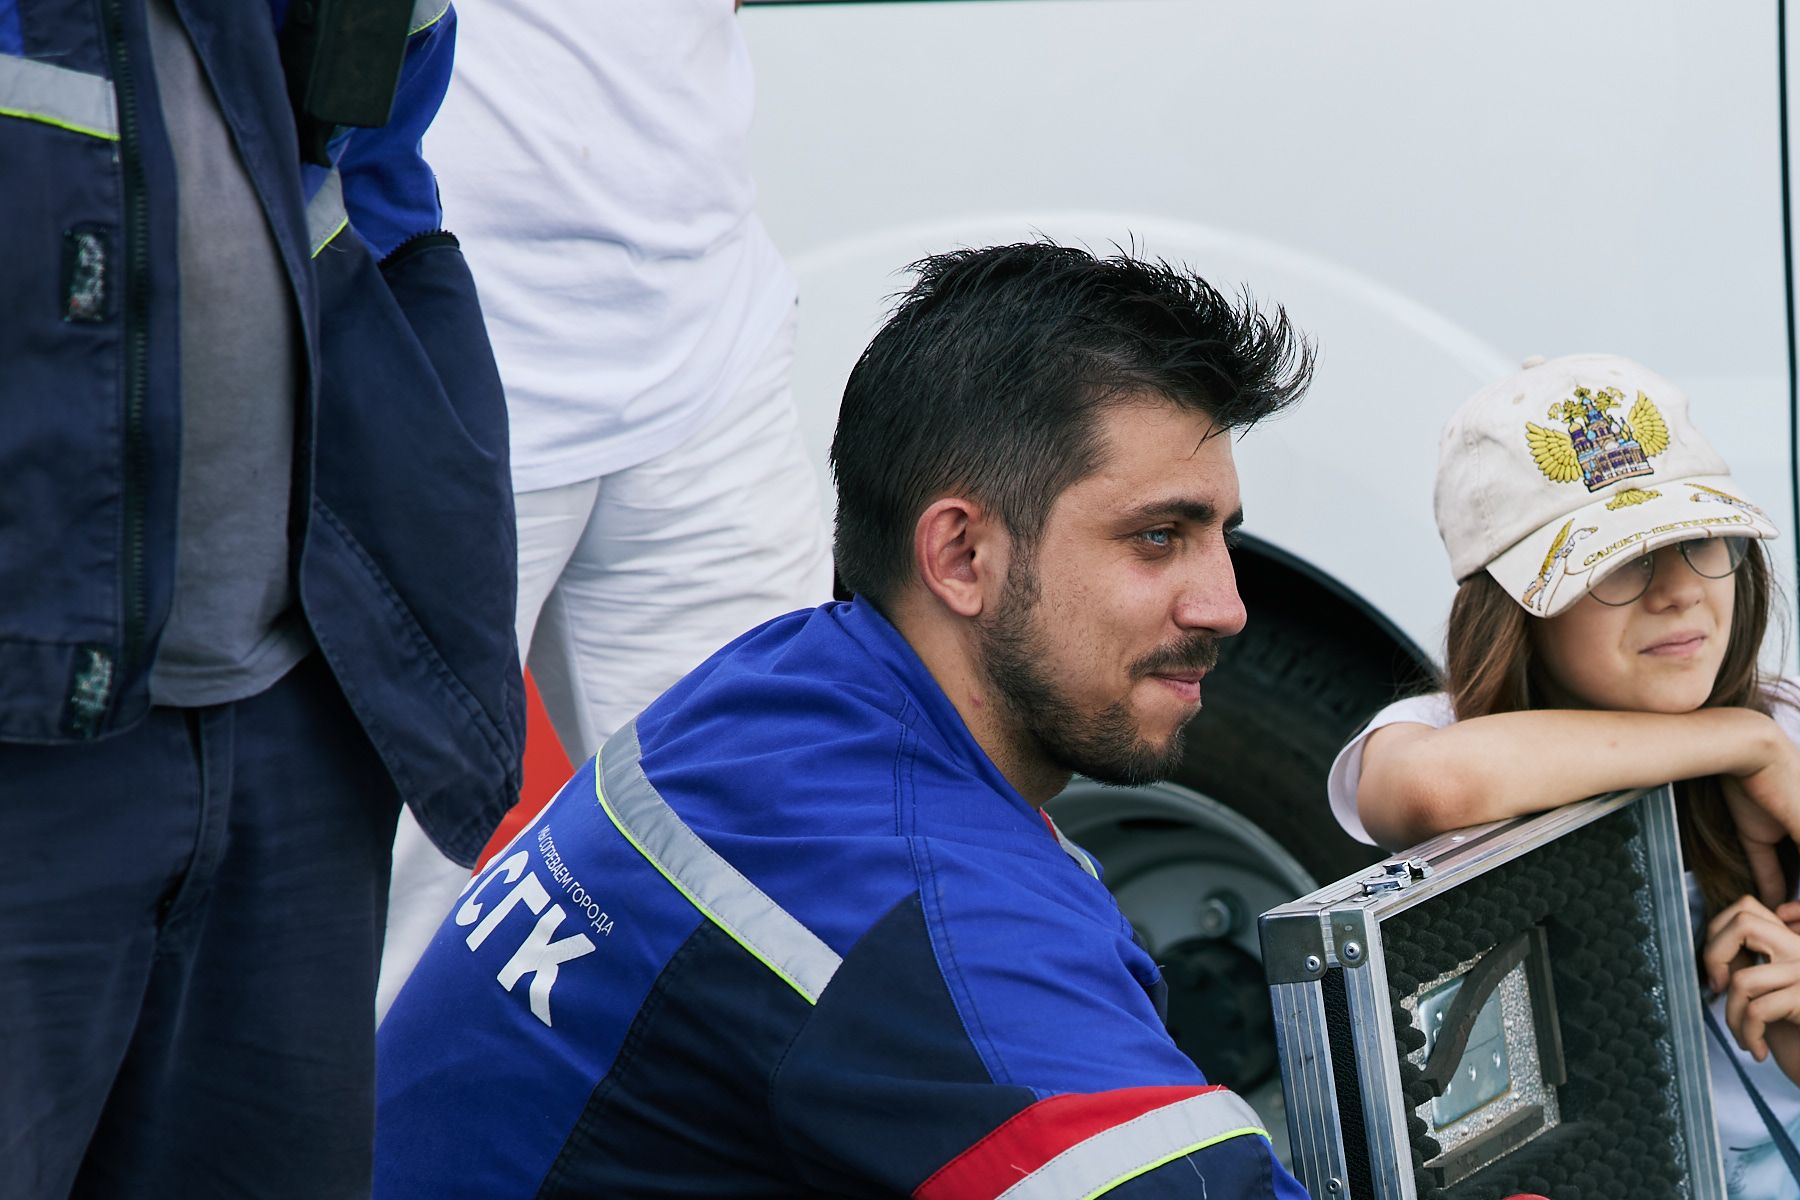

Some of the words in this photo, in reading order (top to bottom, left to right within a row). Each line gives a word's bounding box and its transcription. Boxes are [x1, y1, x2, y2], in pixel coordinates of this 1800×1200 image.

[455, 850, 596, 1028] СГК
[539, 836, 574, 889] СОГРЕВАЕМ
[566, 881, 615, 937] ГОРОДА
